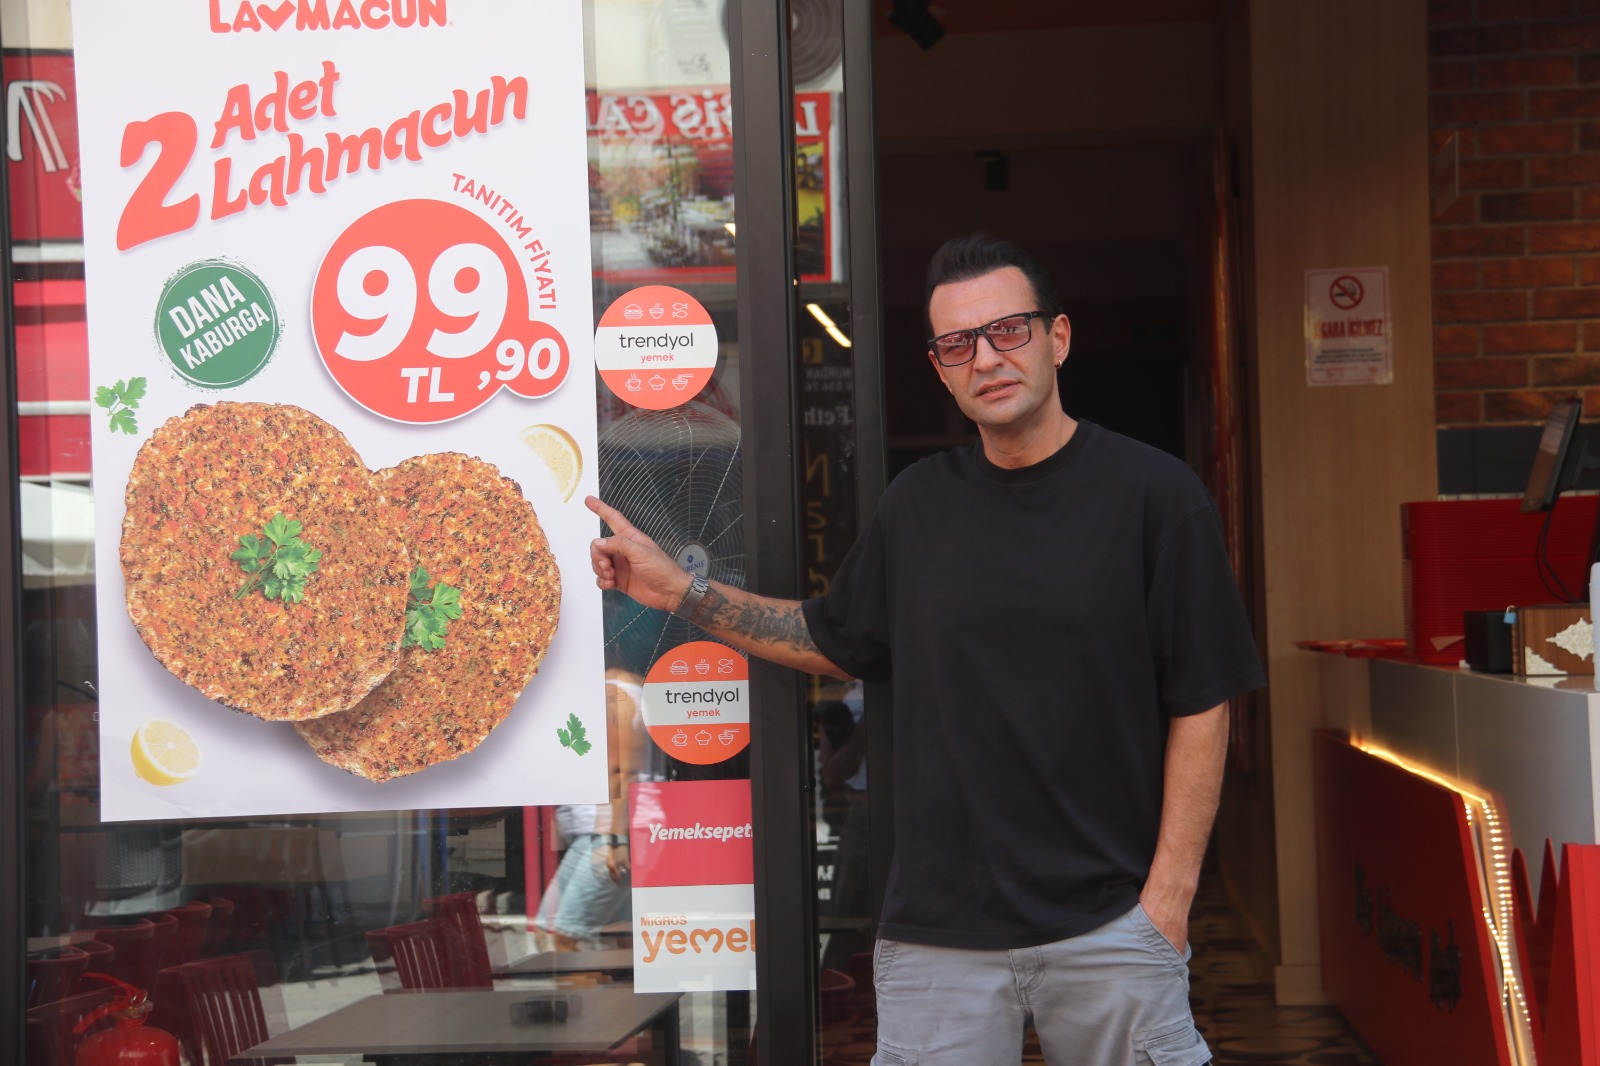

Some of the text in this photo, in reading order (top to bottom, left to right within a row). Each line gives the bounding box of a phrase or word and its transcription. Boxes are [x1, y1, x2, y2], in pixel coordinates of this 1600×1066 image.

[210, 61, 340, 149] Adet
[211, 75, 528, 221] Lahmacun
[116, 111, 200, 251] 2
[453, 172, 557, 309] TANITIM FİYATI
[168, 275, 246, 339] DANA
[334, 243, 508, 361] 99
[180, 301, 270, 370] KABURGA
[619, 332, 694, 350] trendyol
[640, 353, 675, 363] yemek
[400, 367, 455, 403] TL
[665, 687, 739, 705] trendyol
[687, 708, 720, 719] yemek
[649, 823, 753, 843] Yemeksepet
